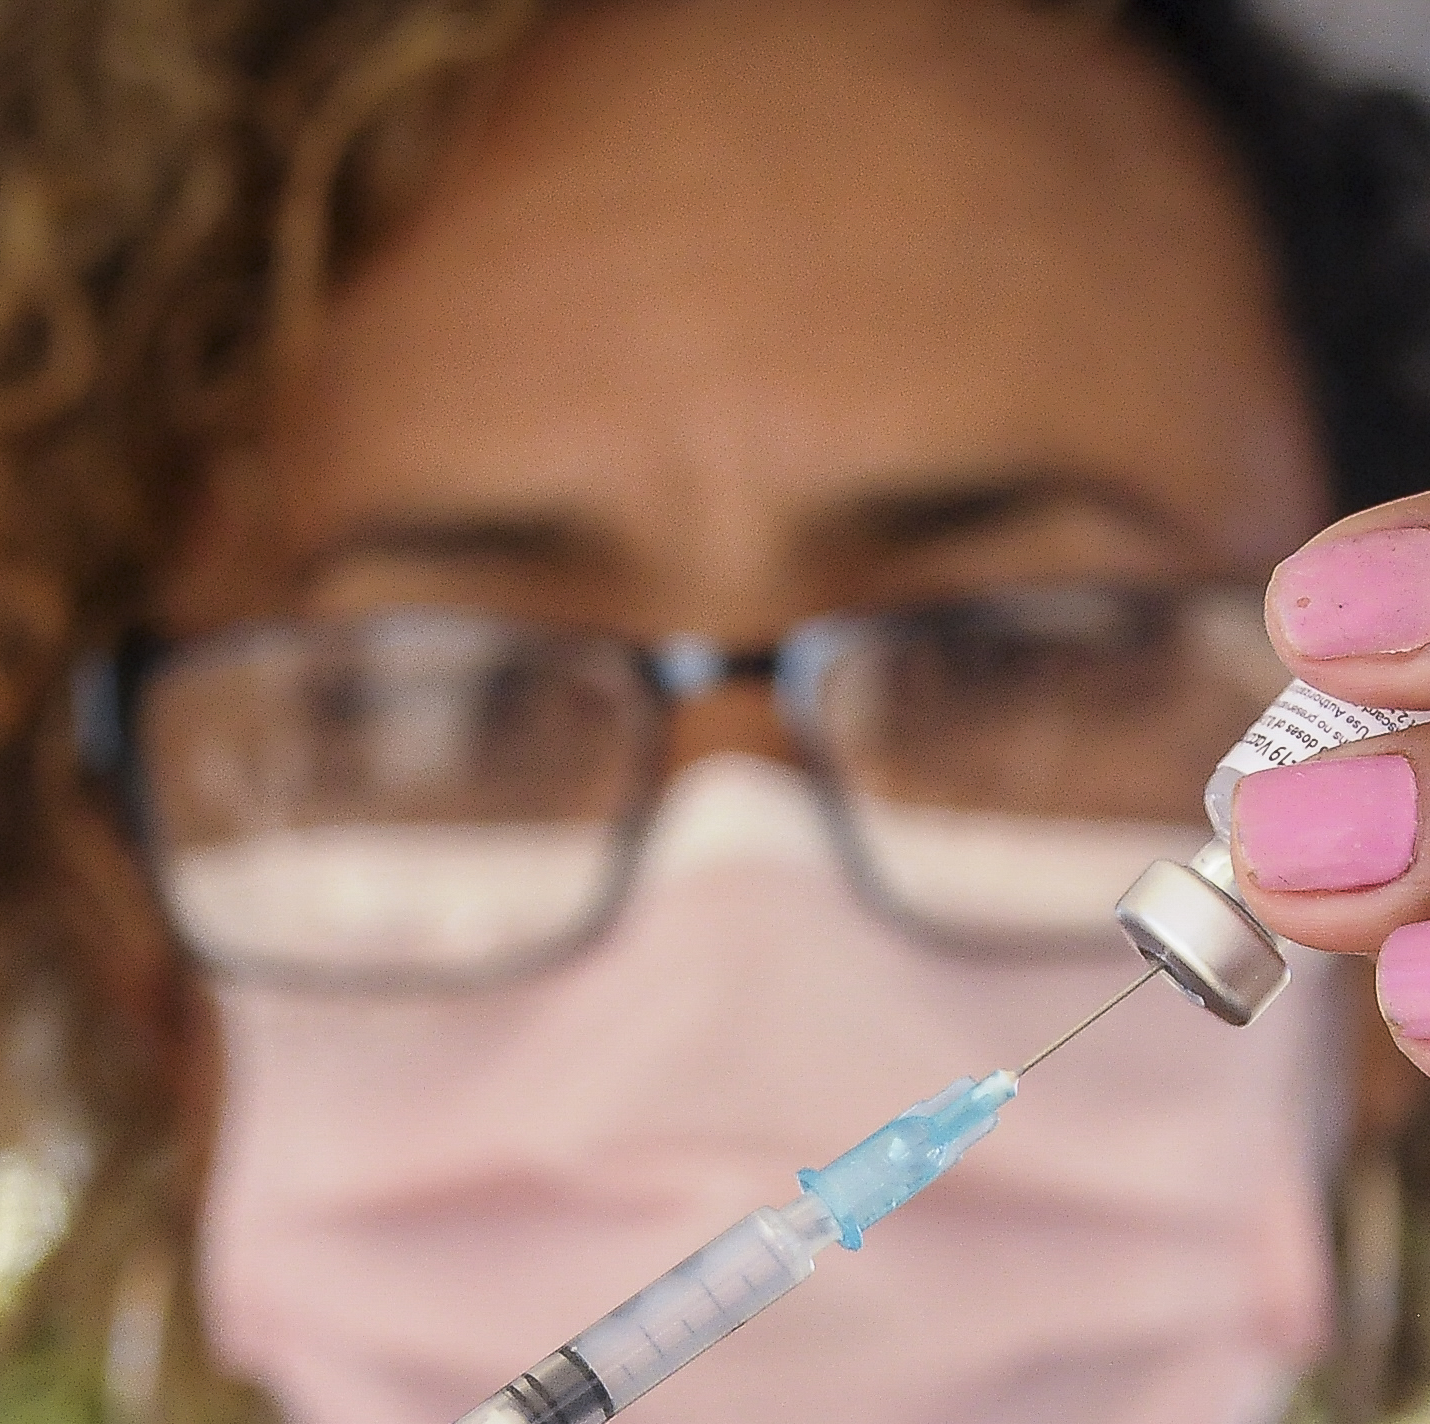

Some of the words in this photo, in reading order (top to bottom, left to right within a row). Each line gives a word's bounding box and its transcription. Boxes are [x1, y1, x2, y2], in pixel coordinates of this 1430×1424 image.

[1285, 723, 1319, 750] doses
[1317, 720, 1332, 733] no
[1345, 715, 1370, 740] Use
